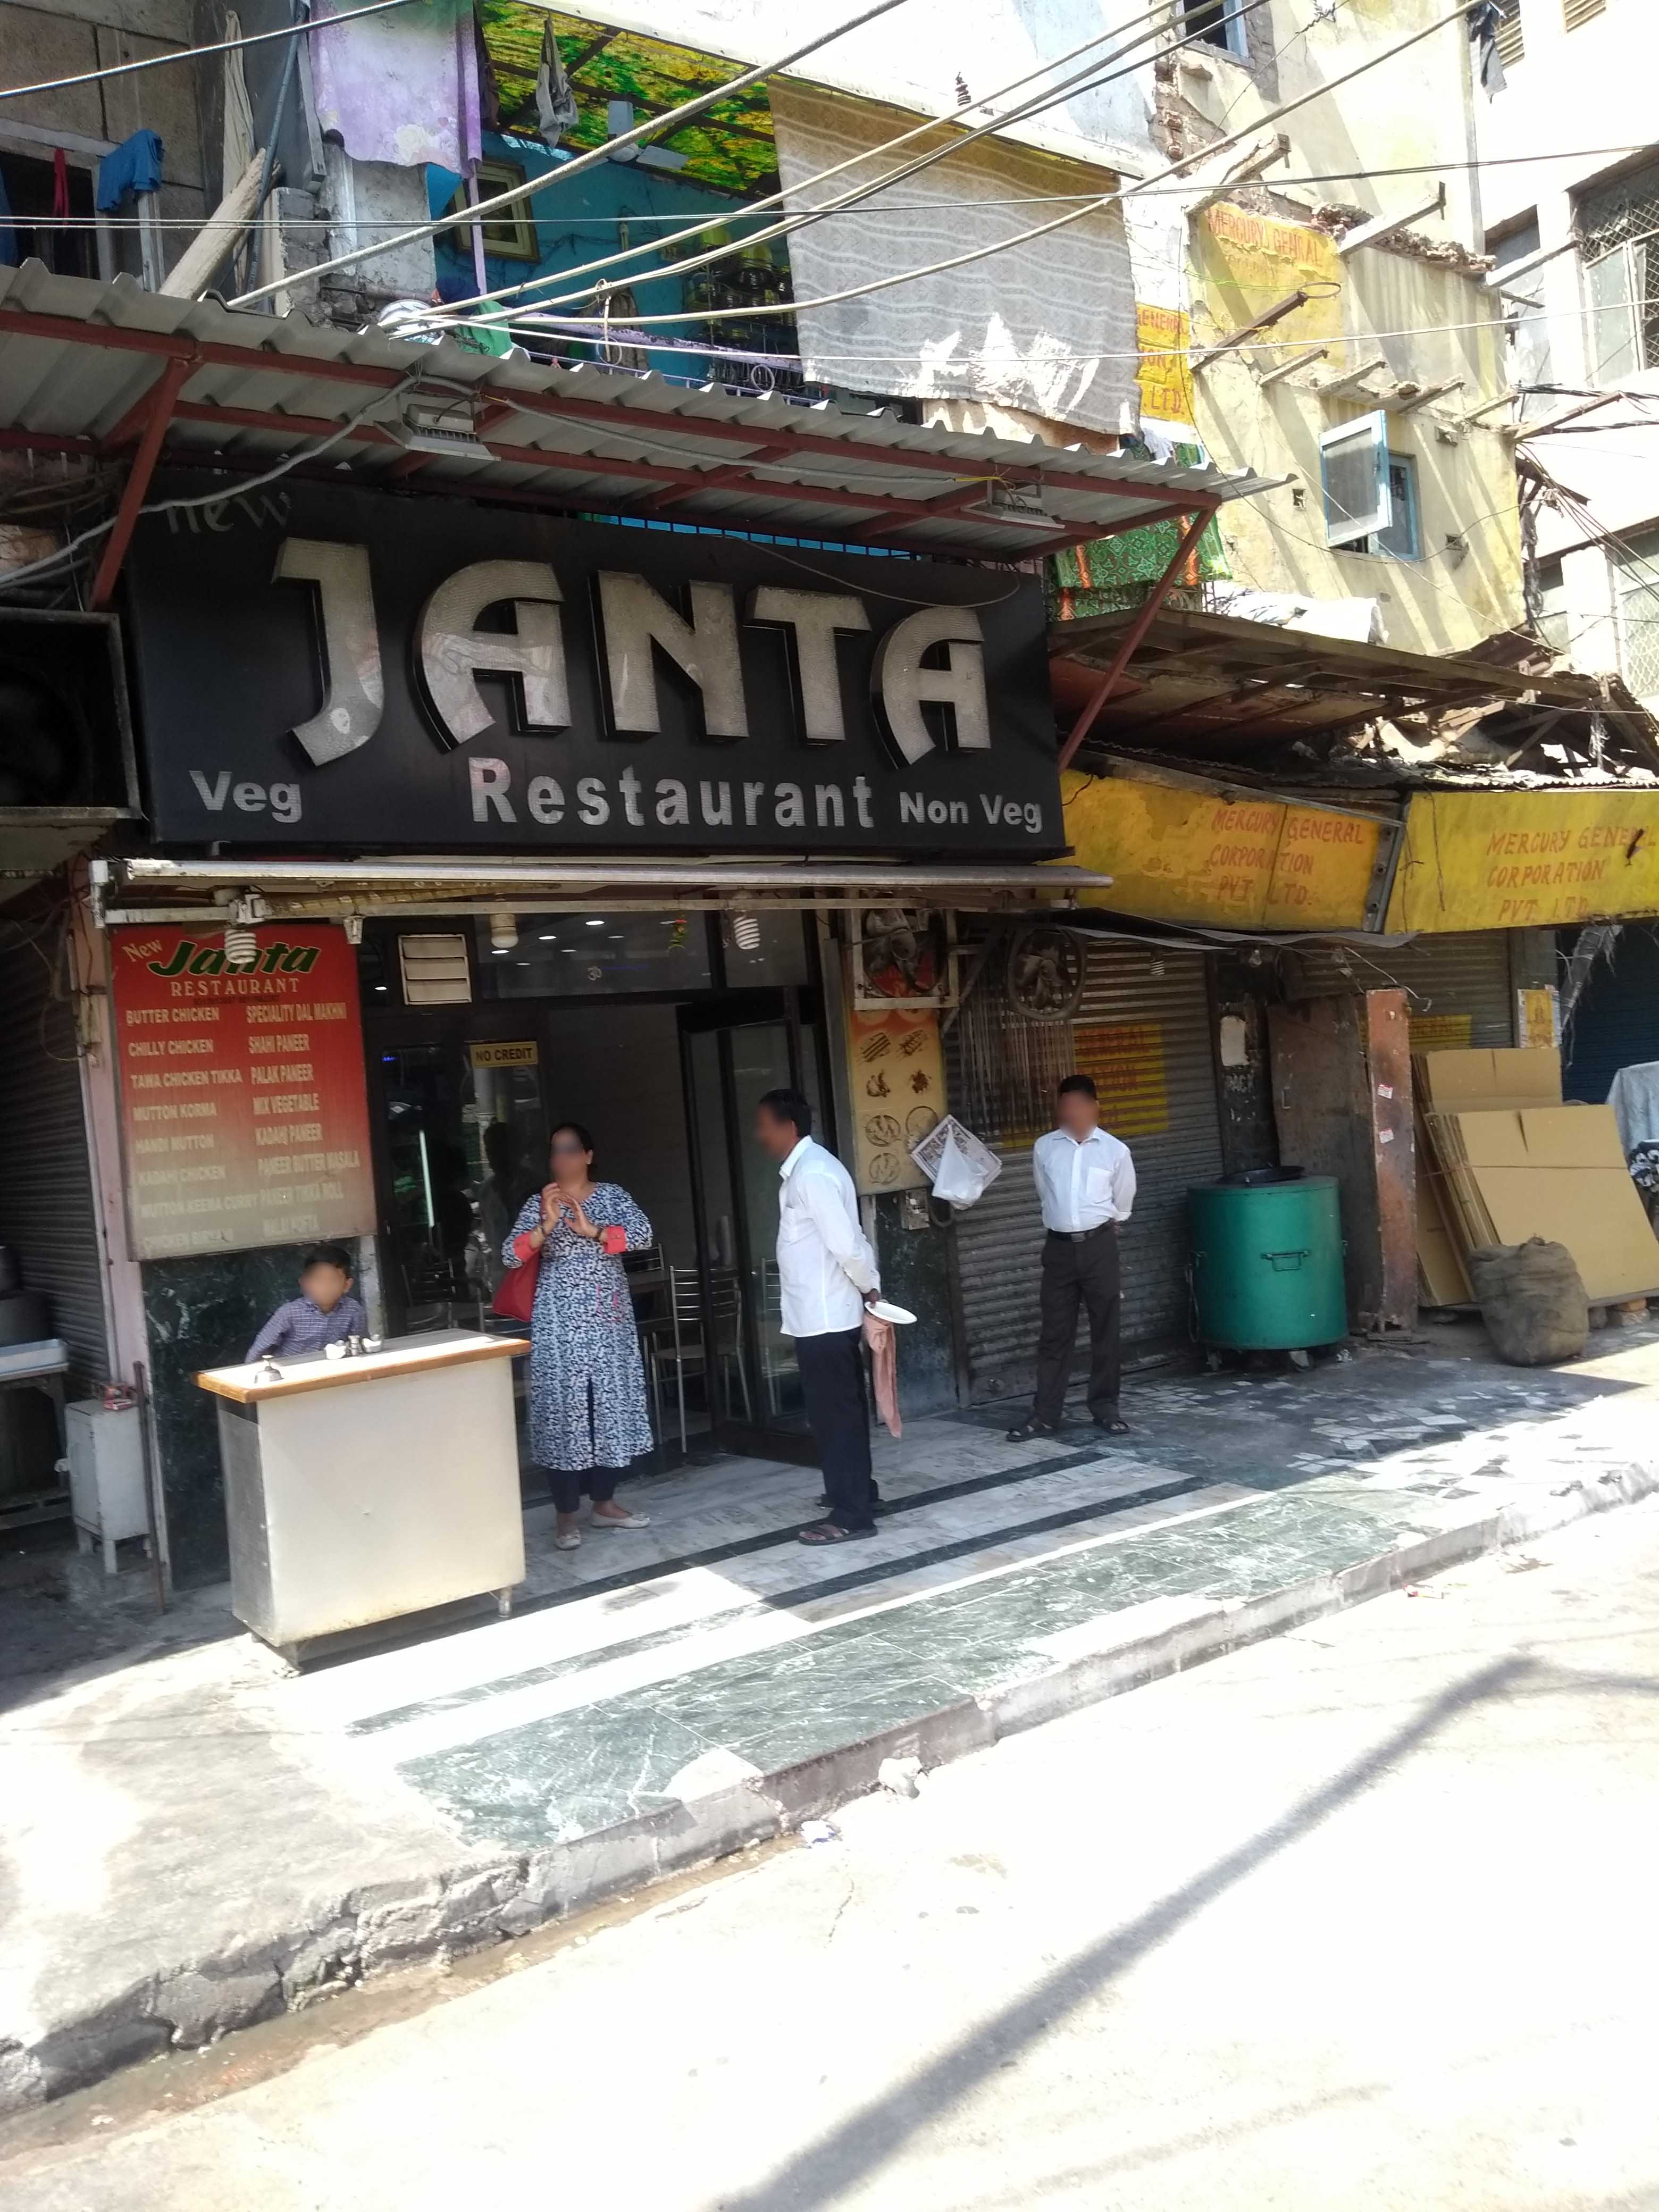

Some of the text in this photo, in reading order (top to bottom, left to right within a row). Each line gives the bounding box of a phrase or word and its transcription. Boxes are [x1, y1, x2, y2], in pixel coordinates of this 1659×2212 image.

[270, 536, 992, 770] JANTA
[189, 770, 302, 824] Veg
[470, 757, 874, 828] Restaurant
[900, 791, 1043, 834] Non Veg
[1212, 808, 1363, 844] MERCURY GENERAL
[1487, 830, 1572, 856] MERCURY
[1487, 859, 1607, 889] CORPORATION
[122, 940, 163, 962] New
[170, 978, 299, 997] RESTAURANT
[125, 1007, 220, 1025] BUTTER CHICKEN
[247, 1004, 294, 1024] SPECIALITY
[296, 1003, 313, 1021] DAL
[128, 1038, 213, 1057] CHILLY CHICKEN
[276, 1033, 310, 1052] PANEER
[476, 1048, 532, 1061] NO CREDIT
[130, 1069, 243, 1089] TAWA CHICKEN TIKKA
[250, 1063, 314, 1084] PALAK PANEER
[133, 1102, 217, 1121] MUTTON KORMA
[270, 1093, 320, 1113] VEGETABLE
[171, 1134, 214, 1151] MUTTON
[289, 1123, 323, 1143] PANEER
